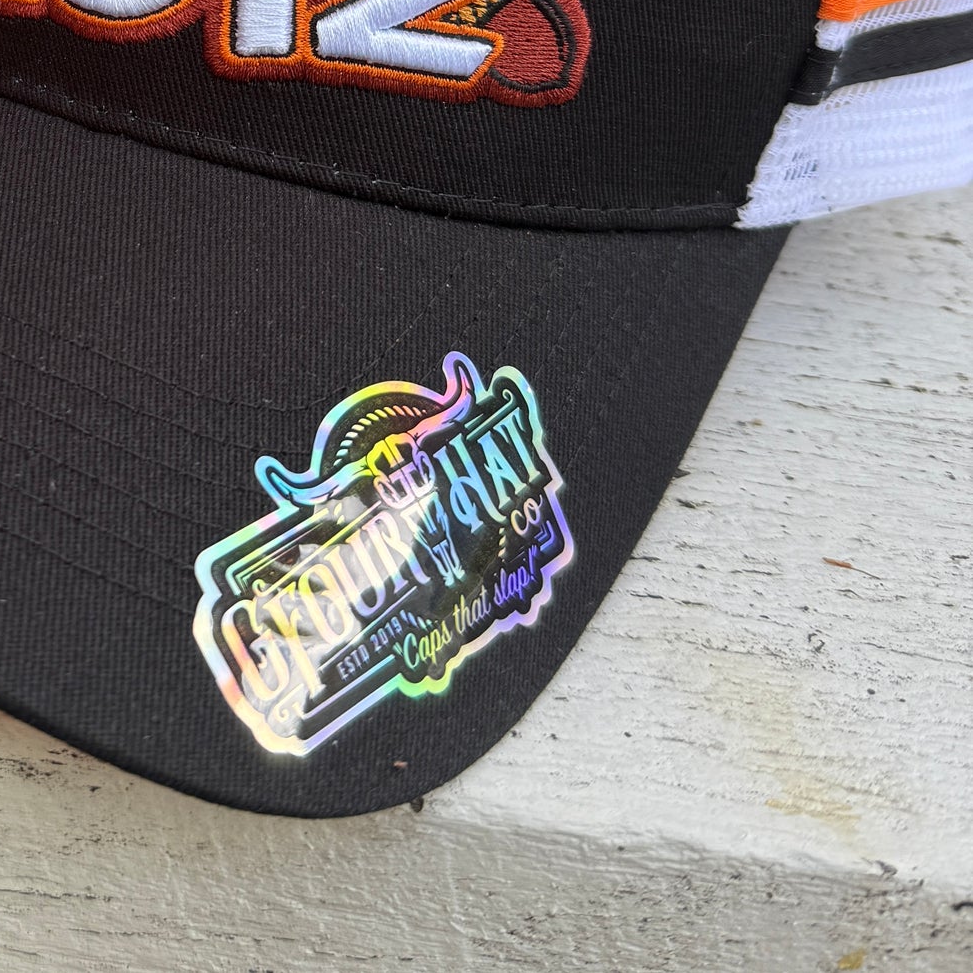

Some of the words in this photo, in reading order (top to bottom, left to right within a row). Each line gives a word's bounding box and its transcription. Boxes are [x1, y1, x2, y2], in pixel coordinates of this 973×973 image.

[432, 407, 541, 534] HAT
[336, 649, 371, 681] ESTD
[369, 616, 404, 652] 2019
[393, 620, 452, 670] "Caps
[452, 584, 492, 635] that
